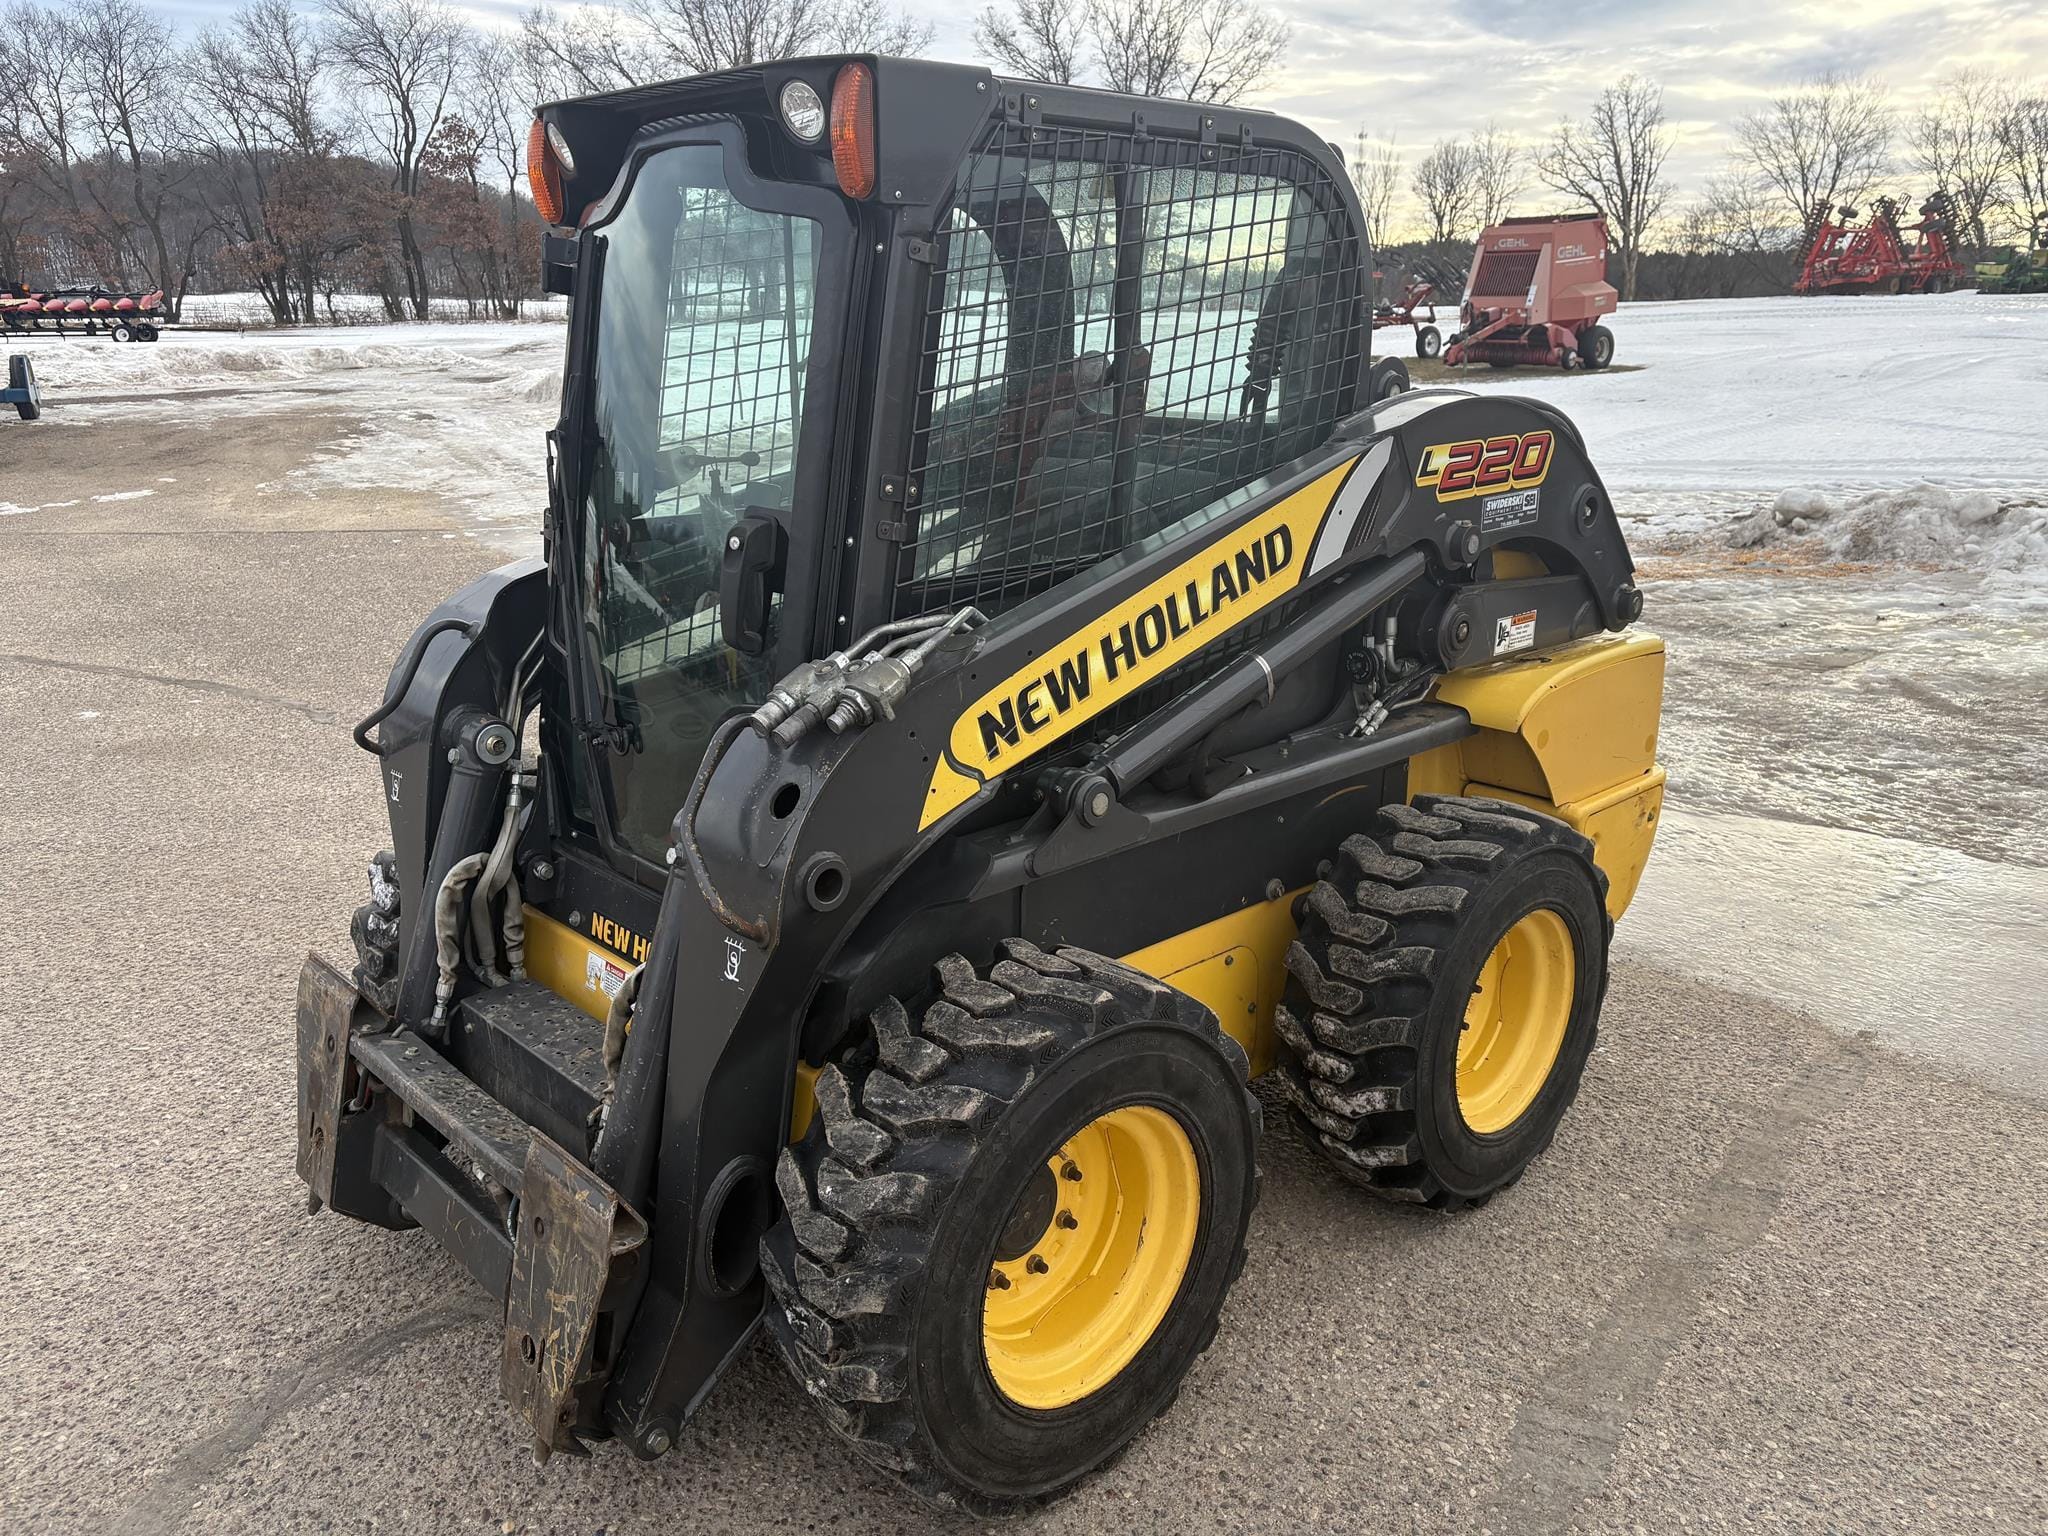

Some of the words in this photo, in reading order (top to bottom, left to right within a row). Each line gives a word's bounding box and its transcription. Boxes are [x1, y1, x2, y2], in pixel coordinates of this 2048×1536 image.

[1498, 238, 1529, 248] GEHL
[1557, 243, 1586, 258] GEHL
[1417, 431, 1553, 497] L220
[1486, 495, 1523, 511] SWIDERSKI
[976, 649, 1091, 761] NEW
[1100, 523, 1293, 683] HOLLAND
[592, 912, 630, 954] NEW
